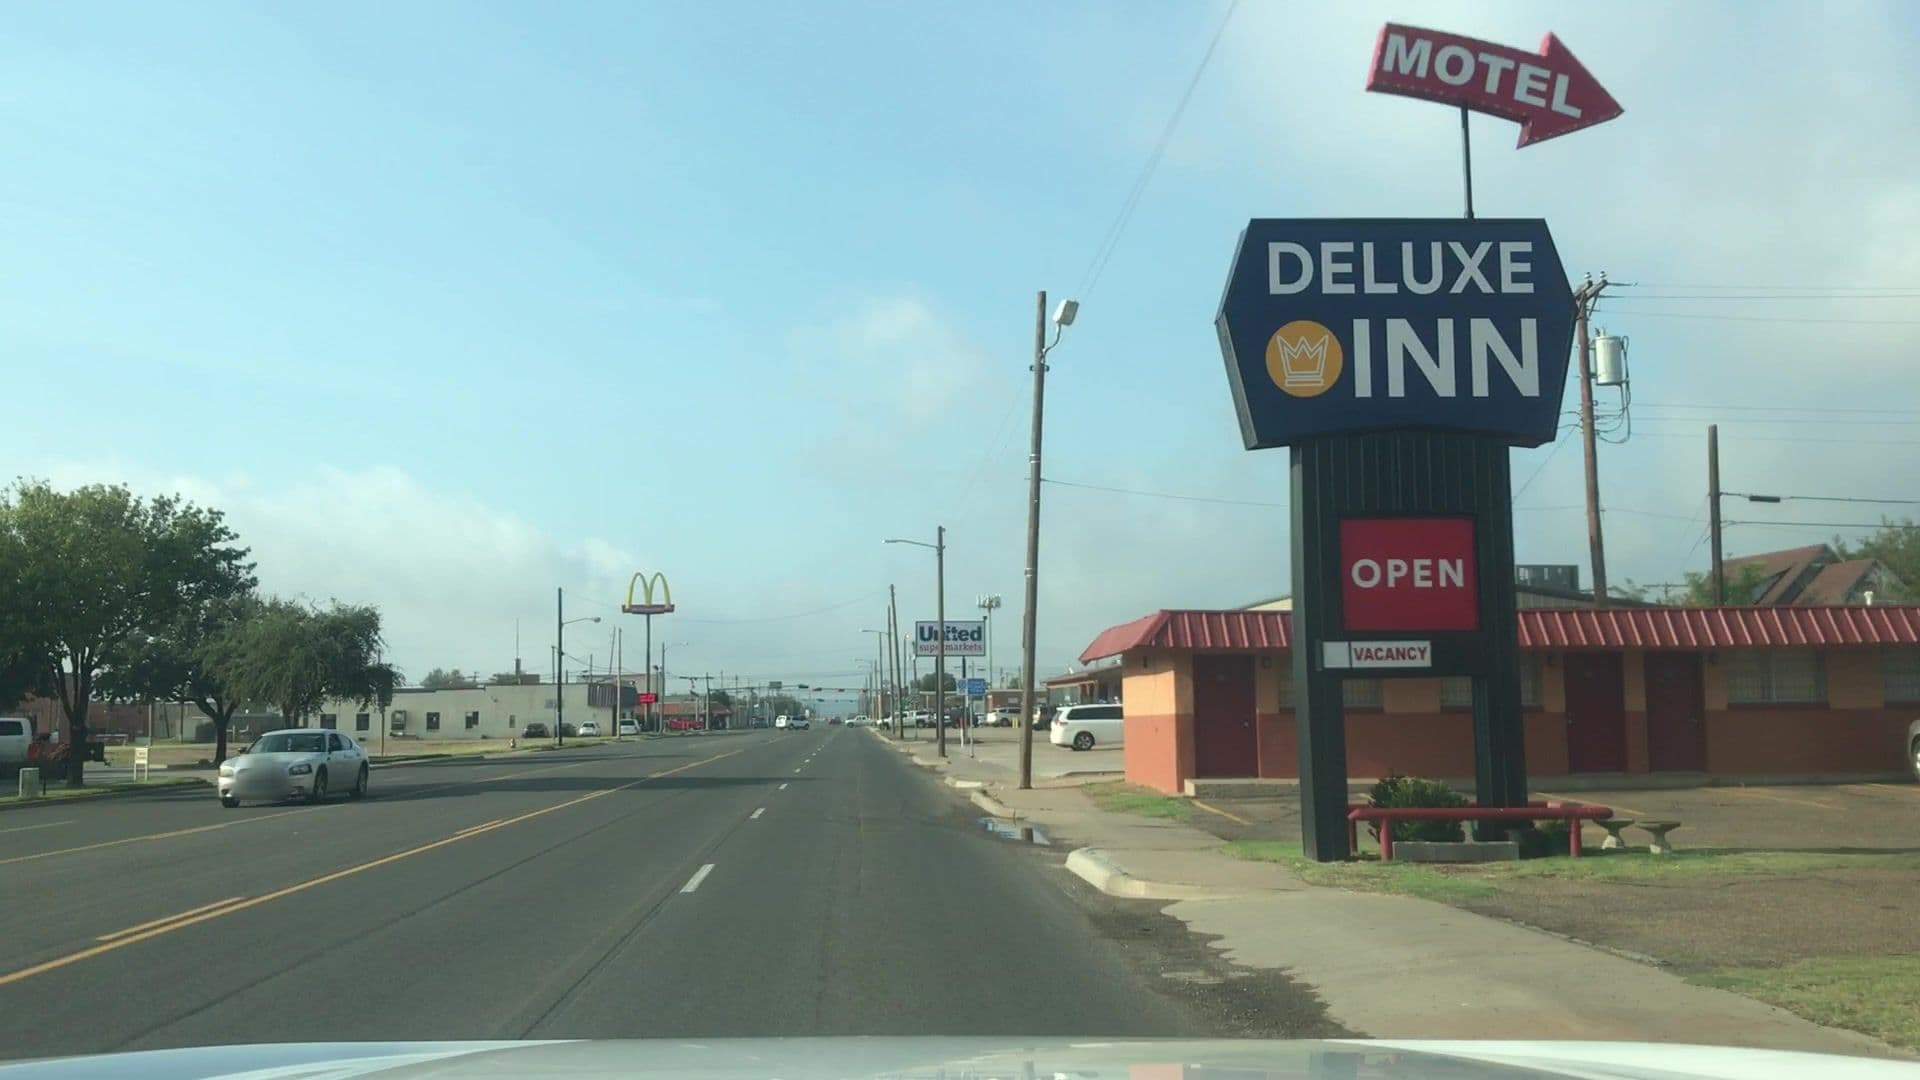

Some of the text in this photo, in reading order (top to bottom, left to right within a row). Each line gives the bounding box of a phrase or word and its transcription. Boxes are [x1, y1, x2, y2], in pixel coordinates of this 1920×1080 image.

[1382, 34, 1582, 118] MOTEL
[1268, 241, 1535, 295] DELUXE
[1353, 318, 1540, 398] INN
[1351, 558, 1465, 588] OPEN
[919, 643, 982, 653] supemarkets
[1353, 646, 1428, 661] VACANCY
